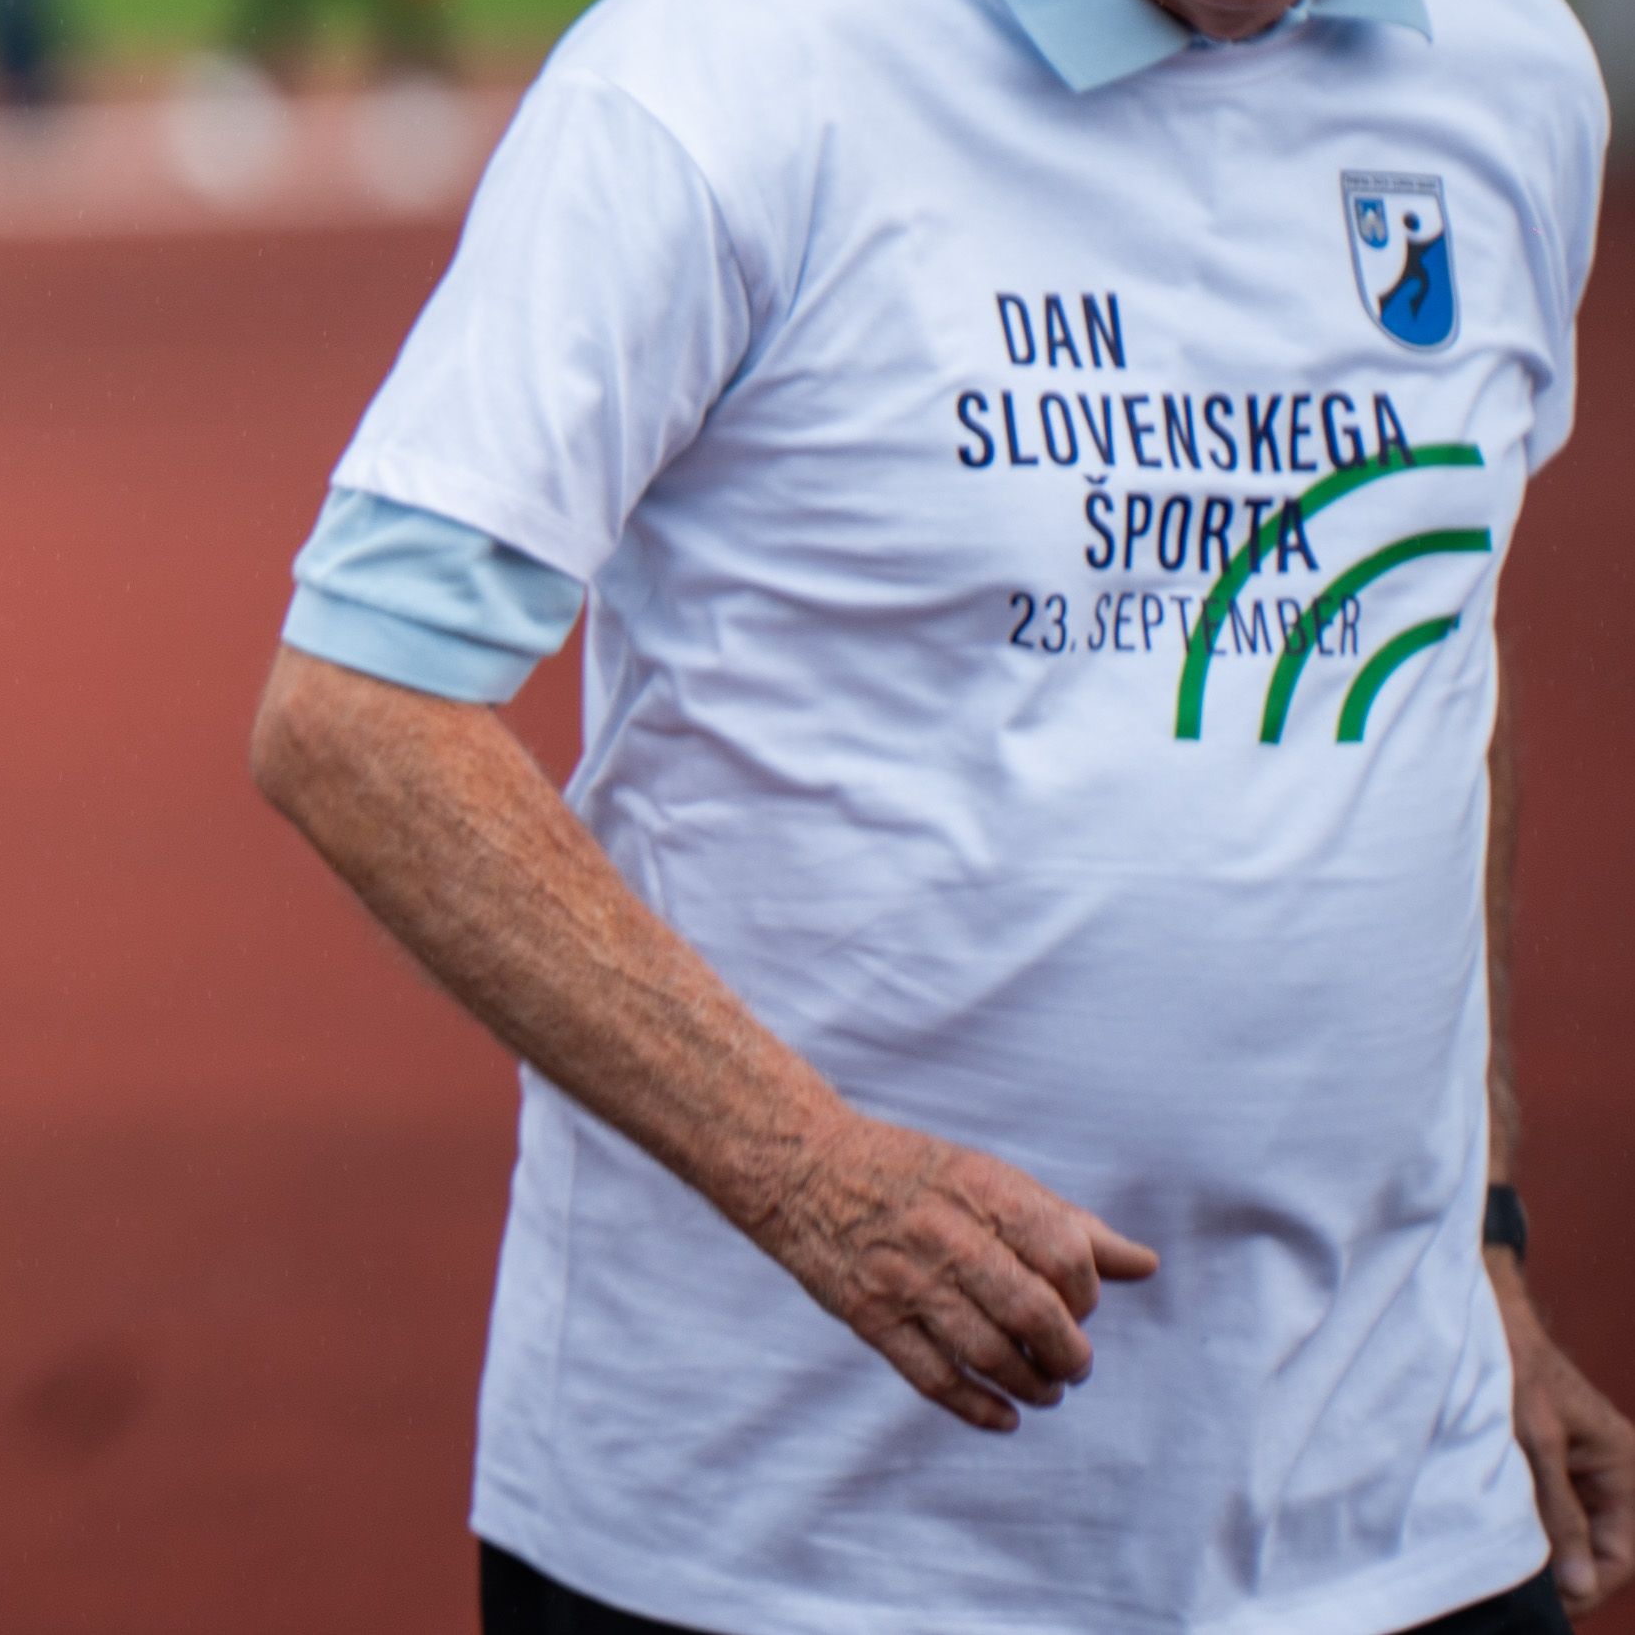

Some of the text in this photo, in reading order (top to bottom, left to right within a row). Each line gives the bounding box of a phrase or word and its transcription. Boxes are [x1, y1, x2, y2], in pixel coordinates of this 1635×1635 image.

[996, 291, 1127, 369] DAN
[956, 389, 1417, 473] SLOVENSKEGA
[1084, 473, 1319, 574] ŠPORTA
[1009, 591, 1362, 657] 23. SEPTEMBER
